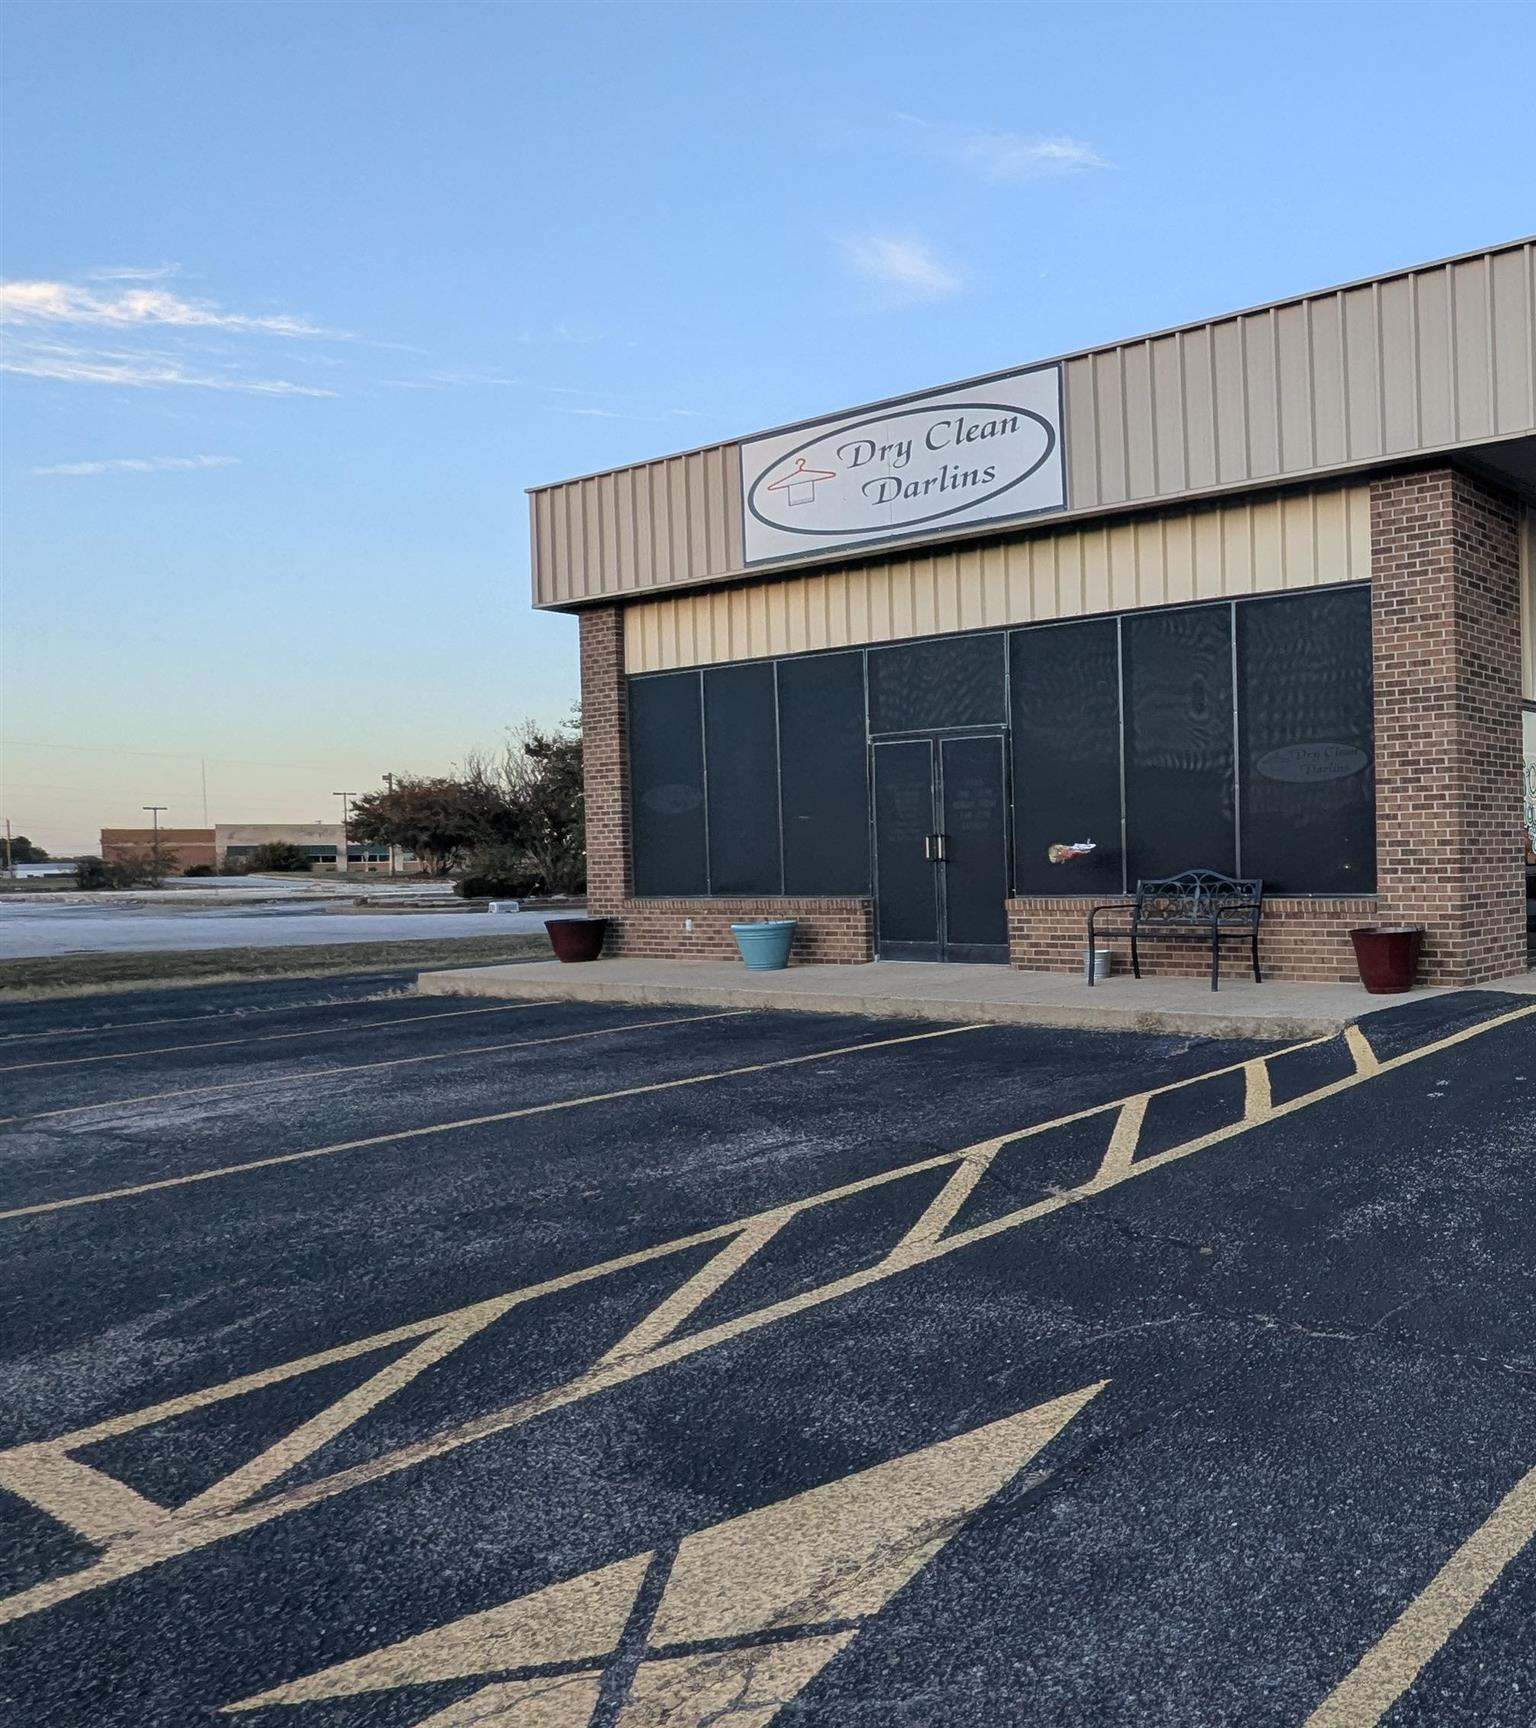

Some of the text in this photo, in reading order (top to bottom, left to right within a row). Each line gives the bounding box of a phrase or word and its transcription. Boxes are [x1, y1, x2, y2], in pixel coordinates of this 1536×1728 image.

[836, 415, 1020, 469] Dry Clean
[862, 463, 996, 505] Darlins
